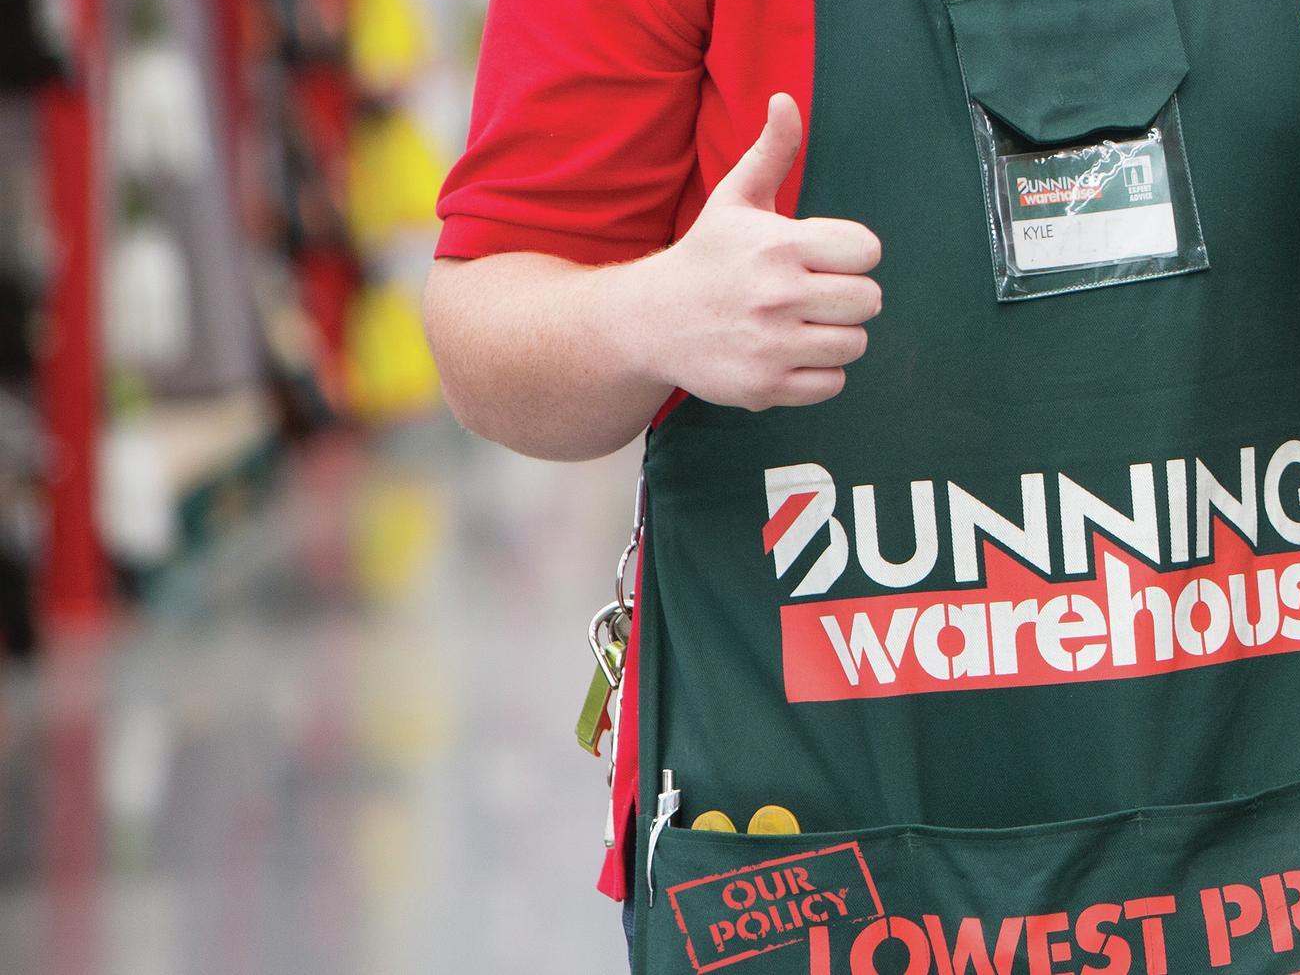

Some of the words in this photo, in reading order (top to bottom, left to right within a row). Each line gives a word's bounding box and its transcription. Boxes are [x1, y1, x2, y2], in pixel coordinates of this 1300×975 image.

[1023, 224, 1054, 241] KYLE
[722, 866, 817, 911] OUR
[708, 887, 849, 954] POLICY
